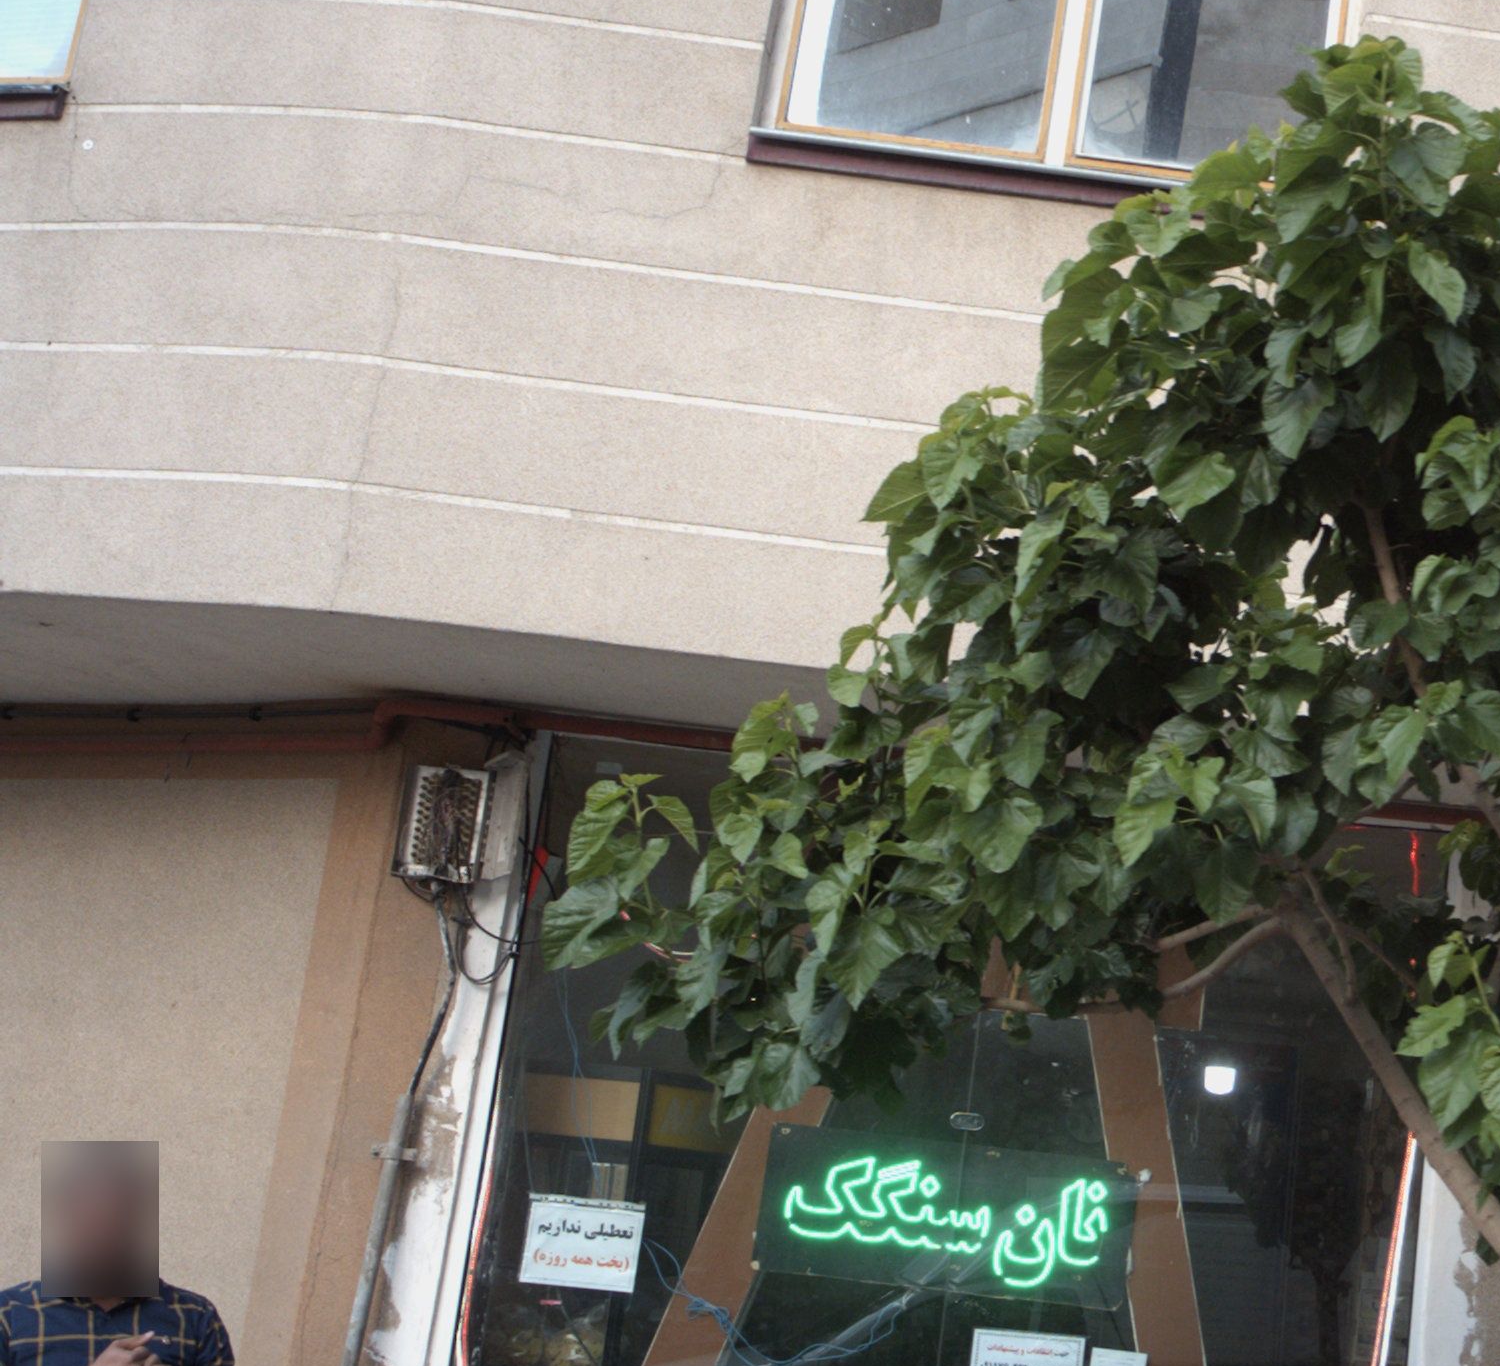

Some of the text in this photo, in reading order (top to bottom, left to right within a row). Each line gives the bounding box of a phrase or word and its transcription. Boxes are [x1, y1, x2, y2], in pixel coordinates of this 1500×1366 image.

[538, 1219, 634, 1241] تعطیلی نداریم
[783, 1155, 1109, 1288] نان سنگک
